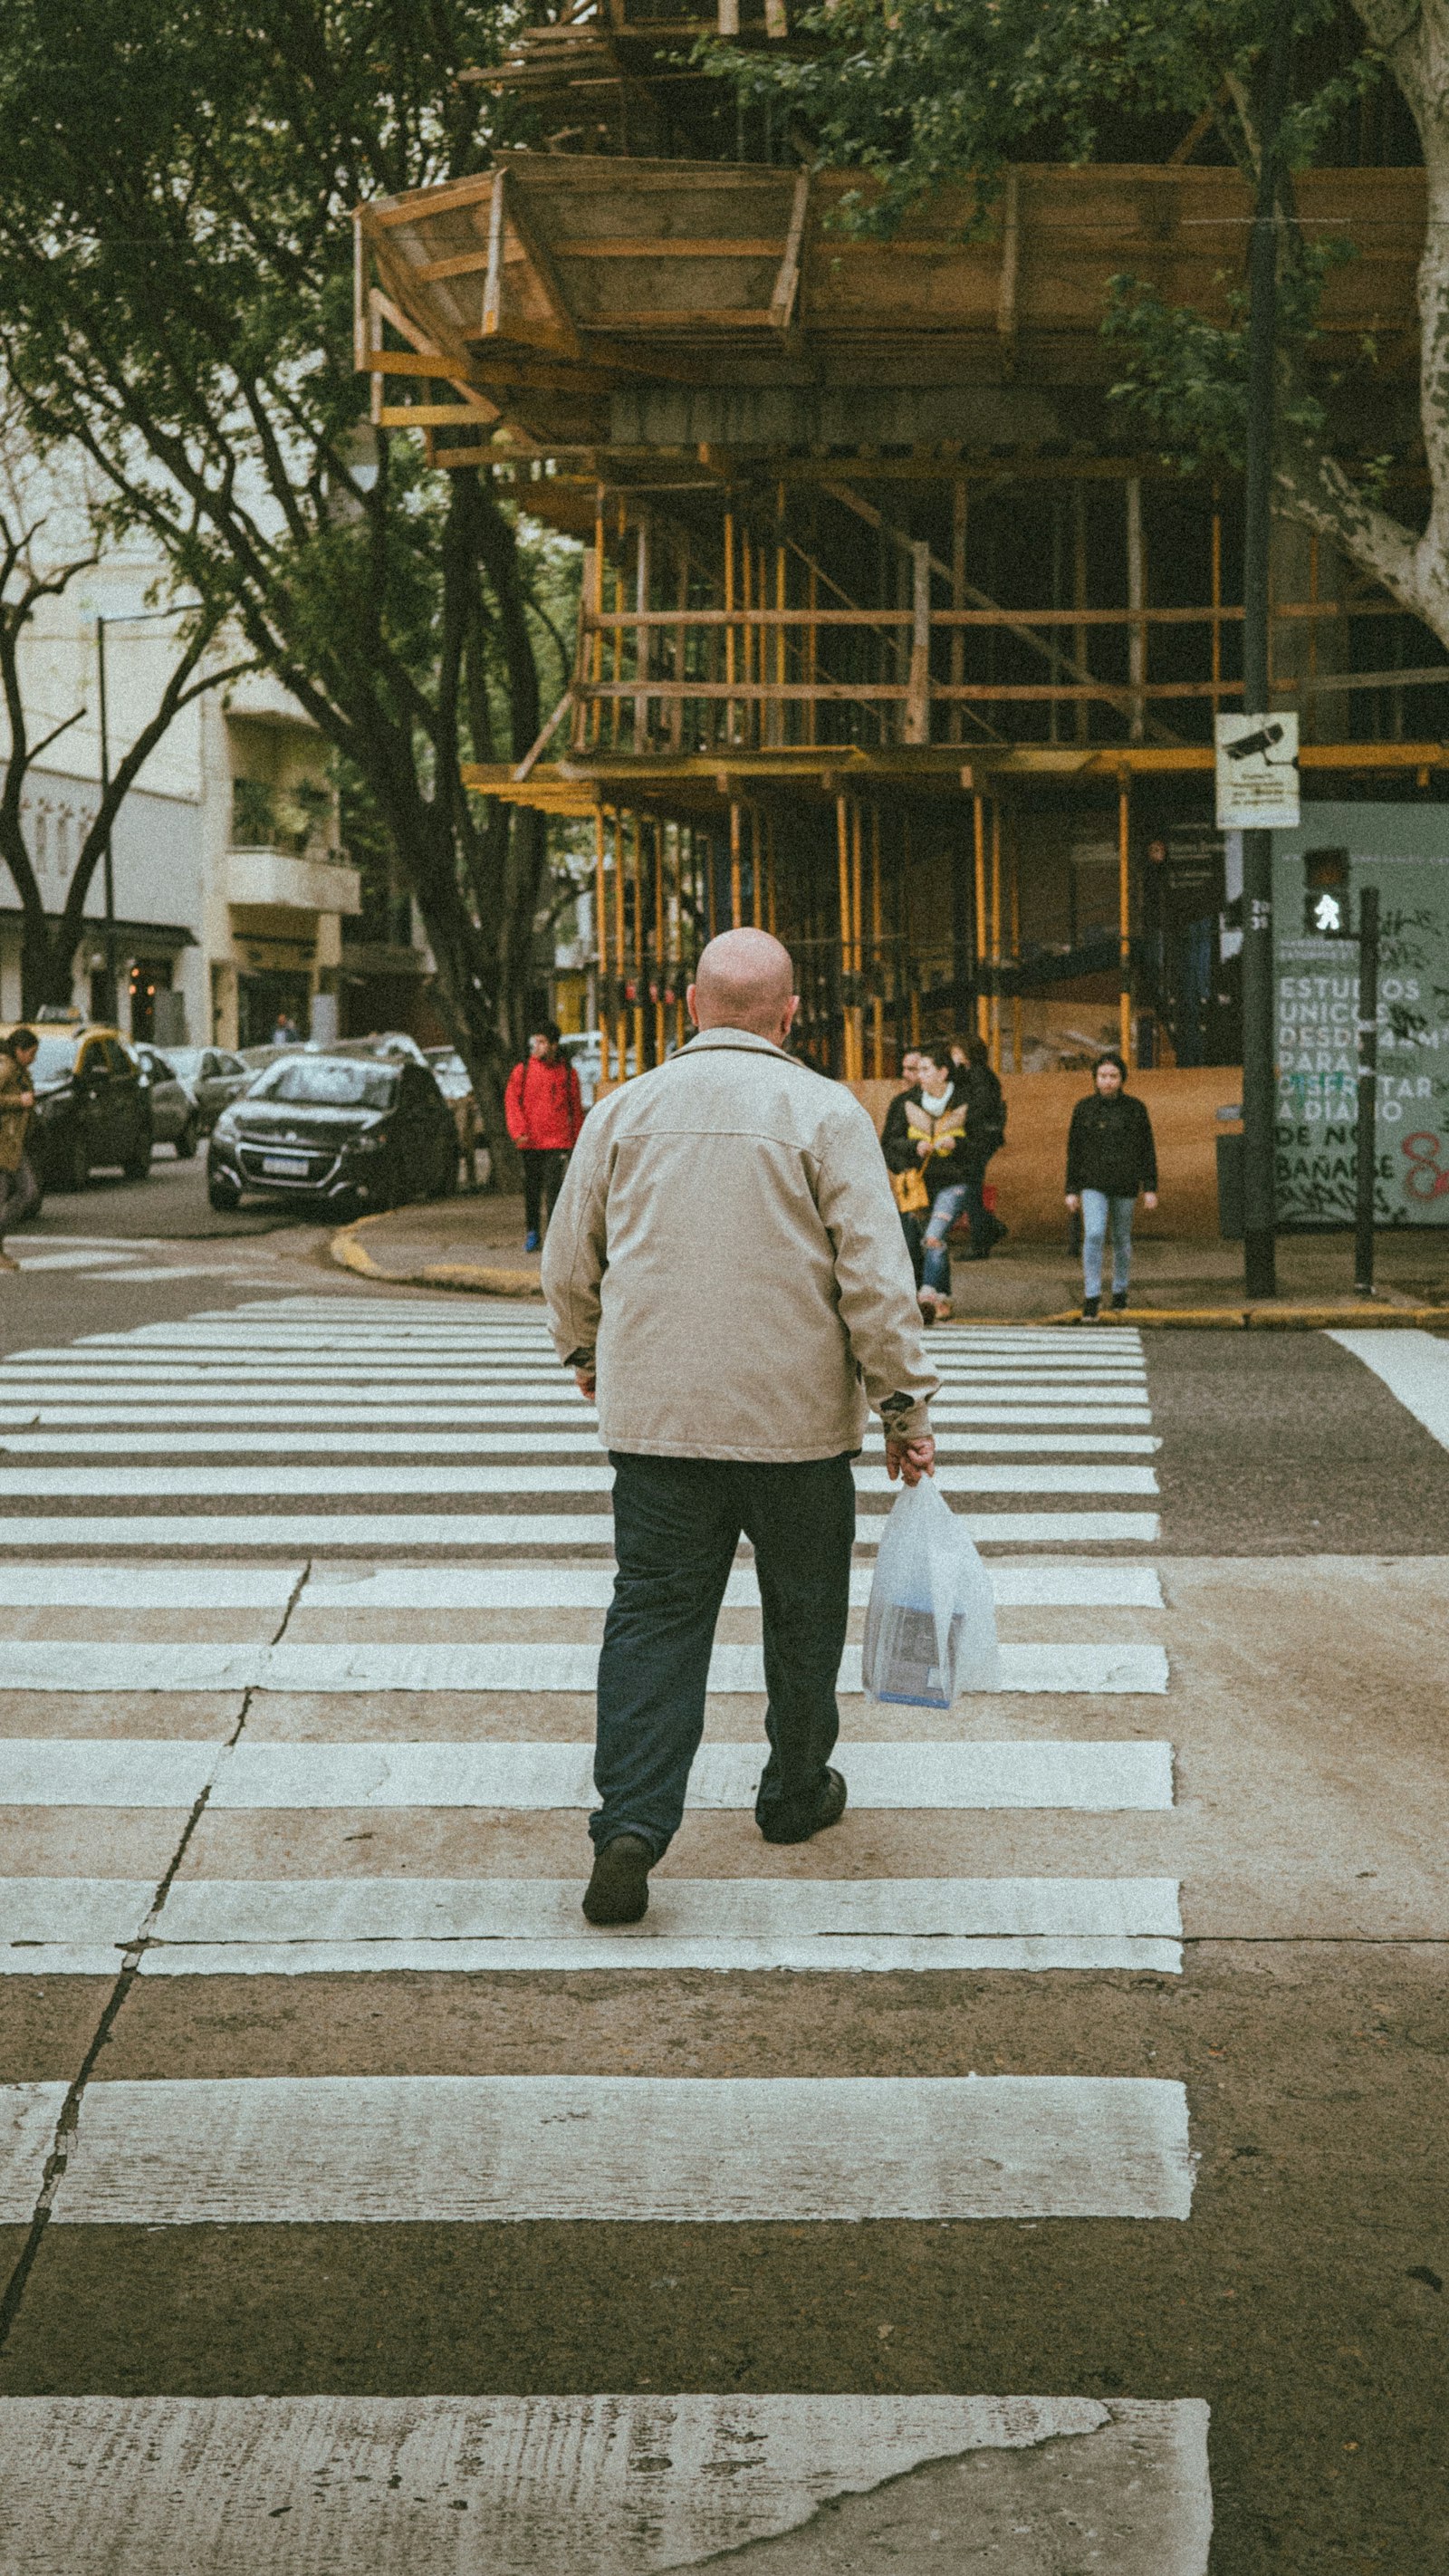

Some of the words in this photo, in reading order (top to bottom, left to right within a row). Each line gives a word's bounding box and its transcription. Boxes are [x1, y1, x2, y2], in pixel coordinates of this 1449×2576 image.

[1280, 977, 1420, 1000] ESTUOS
[1278, 1051, 1351, 1072] PARA
[1278, 1074, 1433, 1098] DISFRTAR
[1278, 1101, 1294, 1120] A
[1275, 1125, 1310, 1147] DE
[1275, 1154, 1394, 1182] BAÑAE
